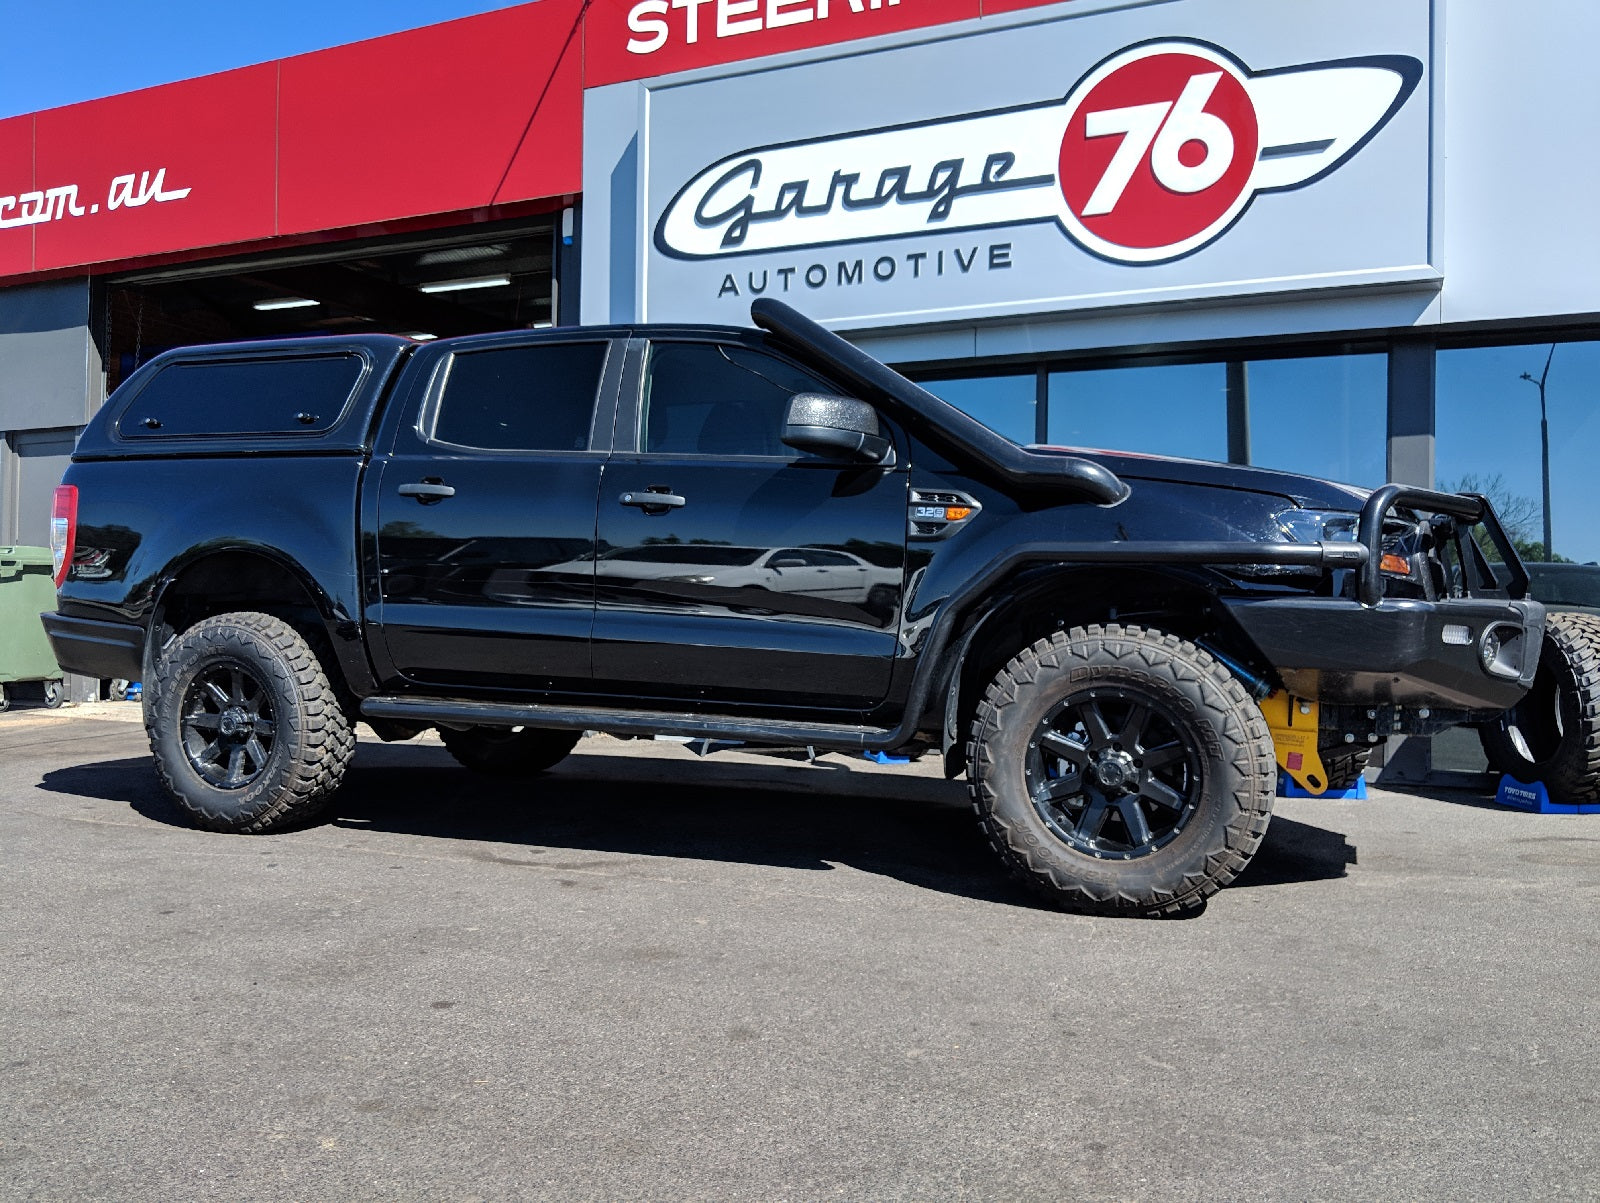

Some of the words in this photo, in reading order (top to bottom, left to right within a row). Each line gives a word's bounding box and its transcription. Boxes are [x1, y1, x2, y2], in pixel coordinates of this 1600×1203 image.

[1080, 70, 1235, 218] 76
[694, 151, 1056, 249] Garage
[717, 242, 1013, 298] AUTOMOTIVE
